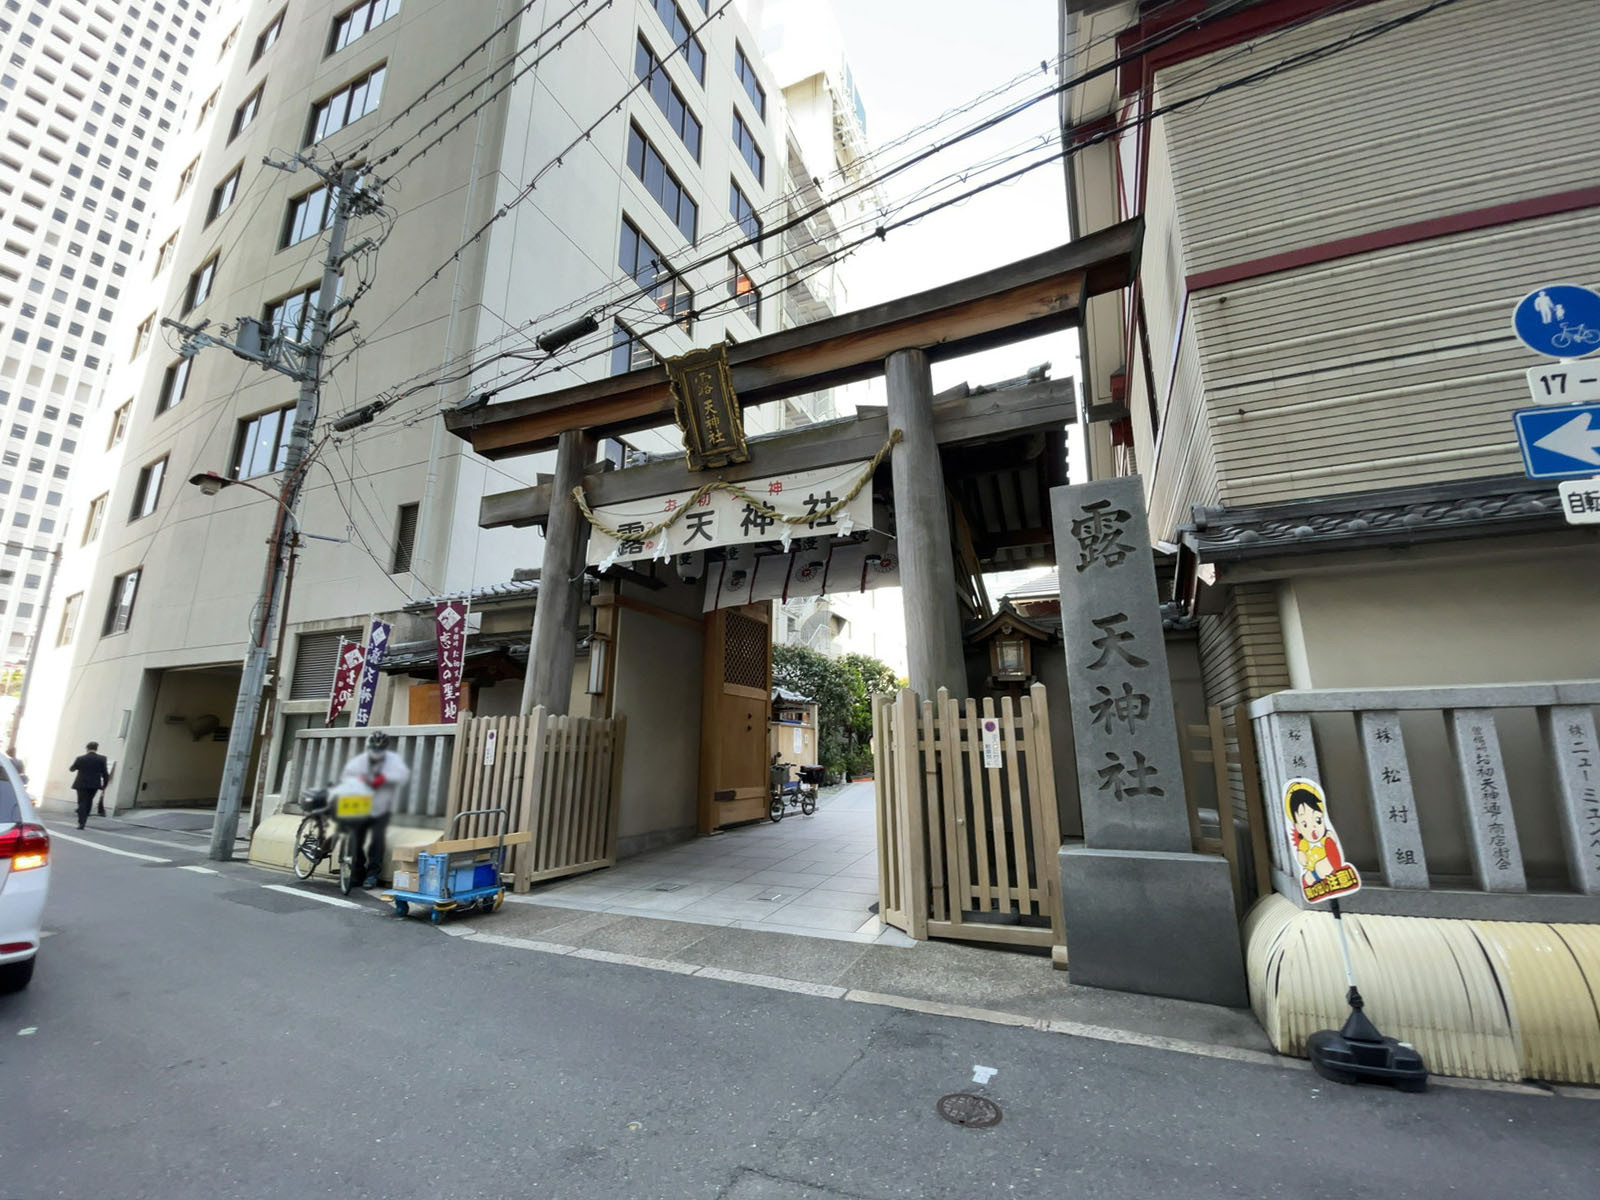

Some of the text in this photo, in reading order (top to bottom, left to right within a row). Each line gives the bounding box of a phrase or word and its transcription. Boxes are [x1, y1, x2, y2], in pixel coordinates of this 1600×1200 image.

[617, 490, 839, 557] 露天神社
[664, 480, 783, 512] お初神
[1070, 498, 1165, 802] 露天神社
